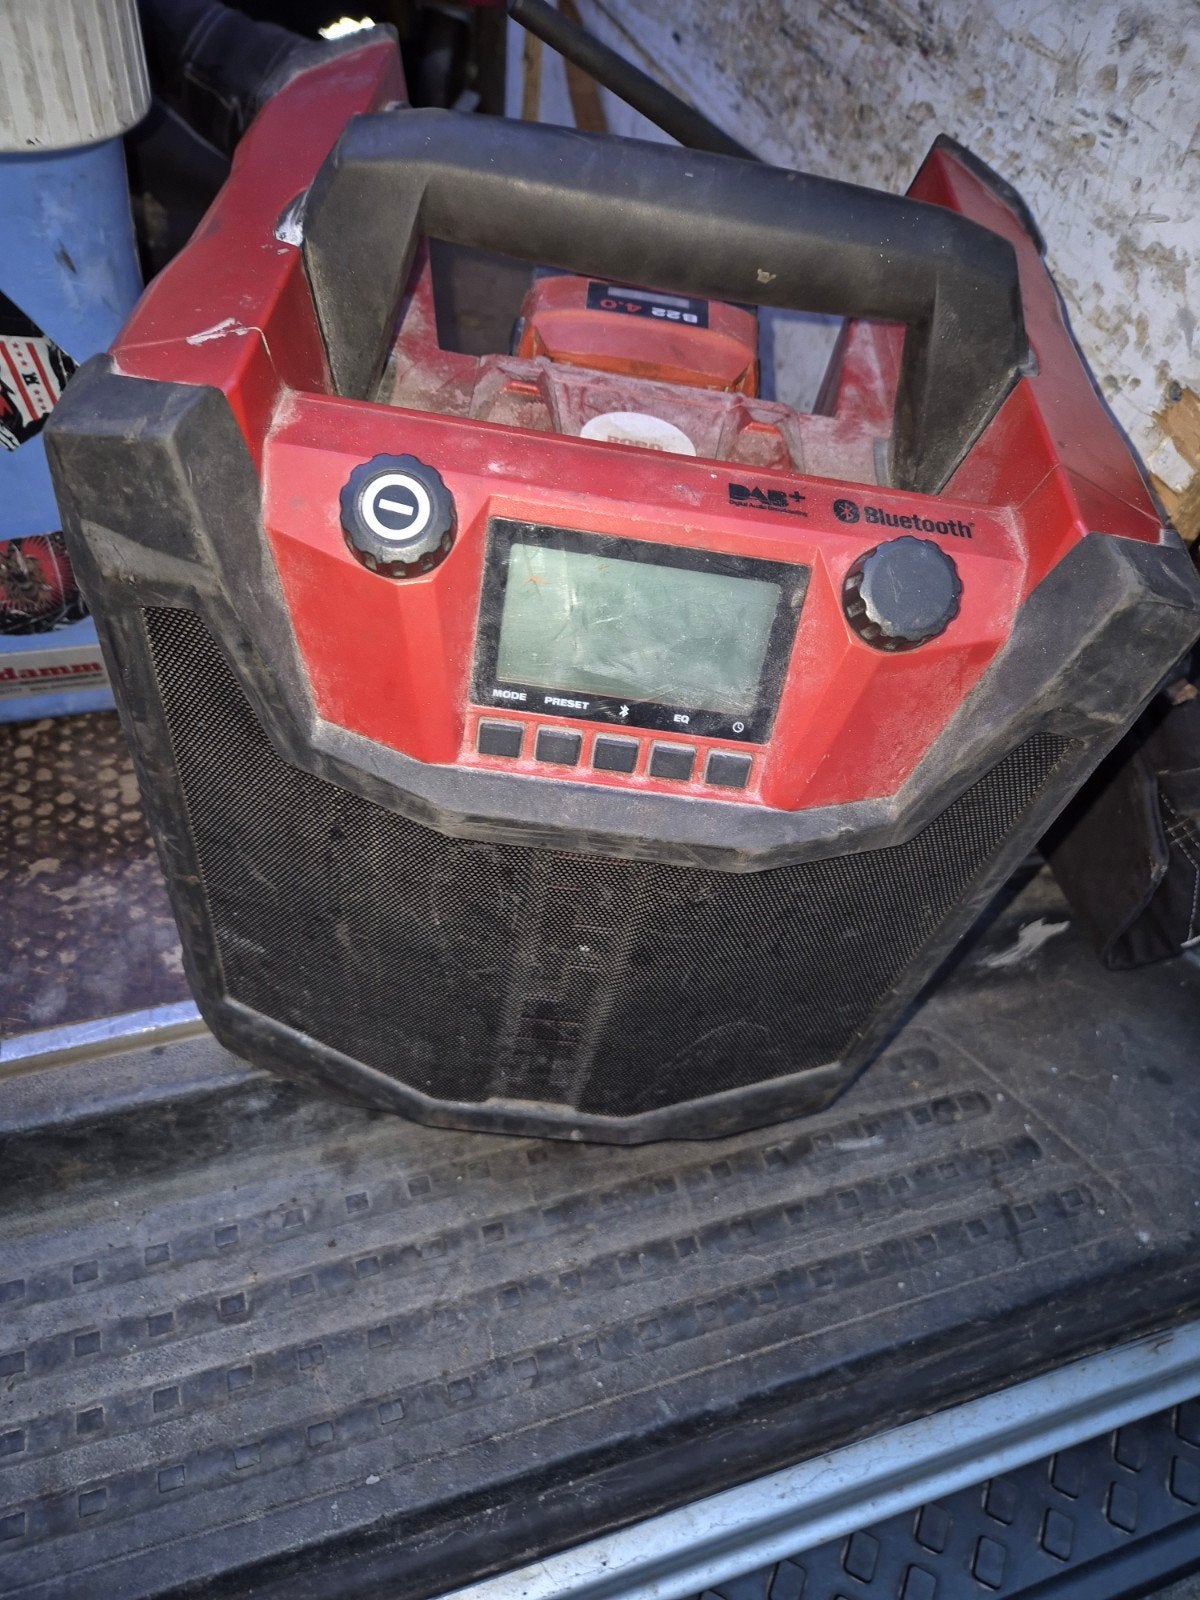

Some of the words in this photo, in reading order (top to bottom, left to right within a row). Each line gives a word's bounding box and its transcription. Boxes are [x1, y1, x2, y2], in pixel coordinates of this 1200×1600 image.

[600, 299, 642, 312] 4.0
[651, 307, 698, 323] B22
[864, 506, 973, 539] Bluetooth
[492, 689, 527, 702] MODE
[544, 696, 590, 710] PRESET
[673, 714, 690, 725] EQ
